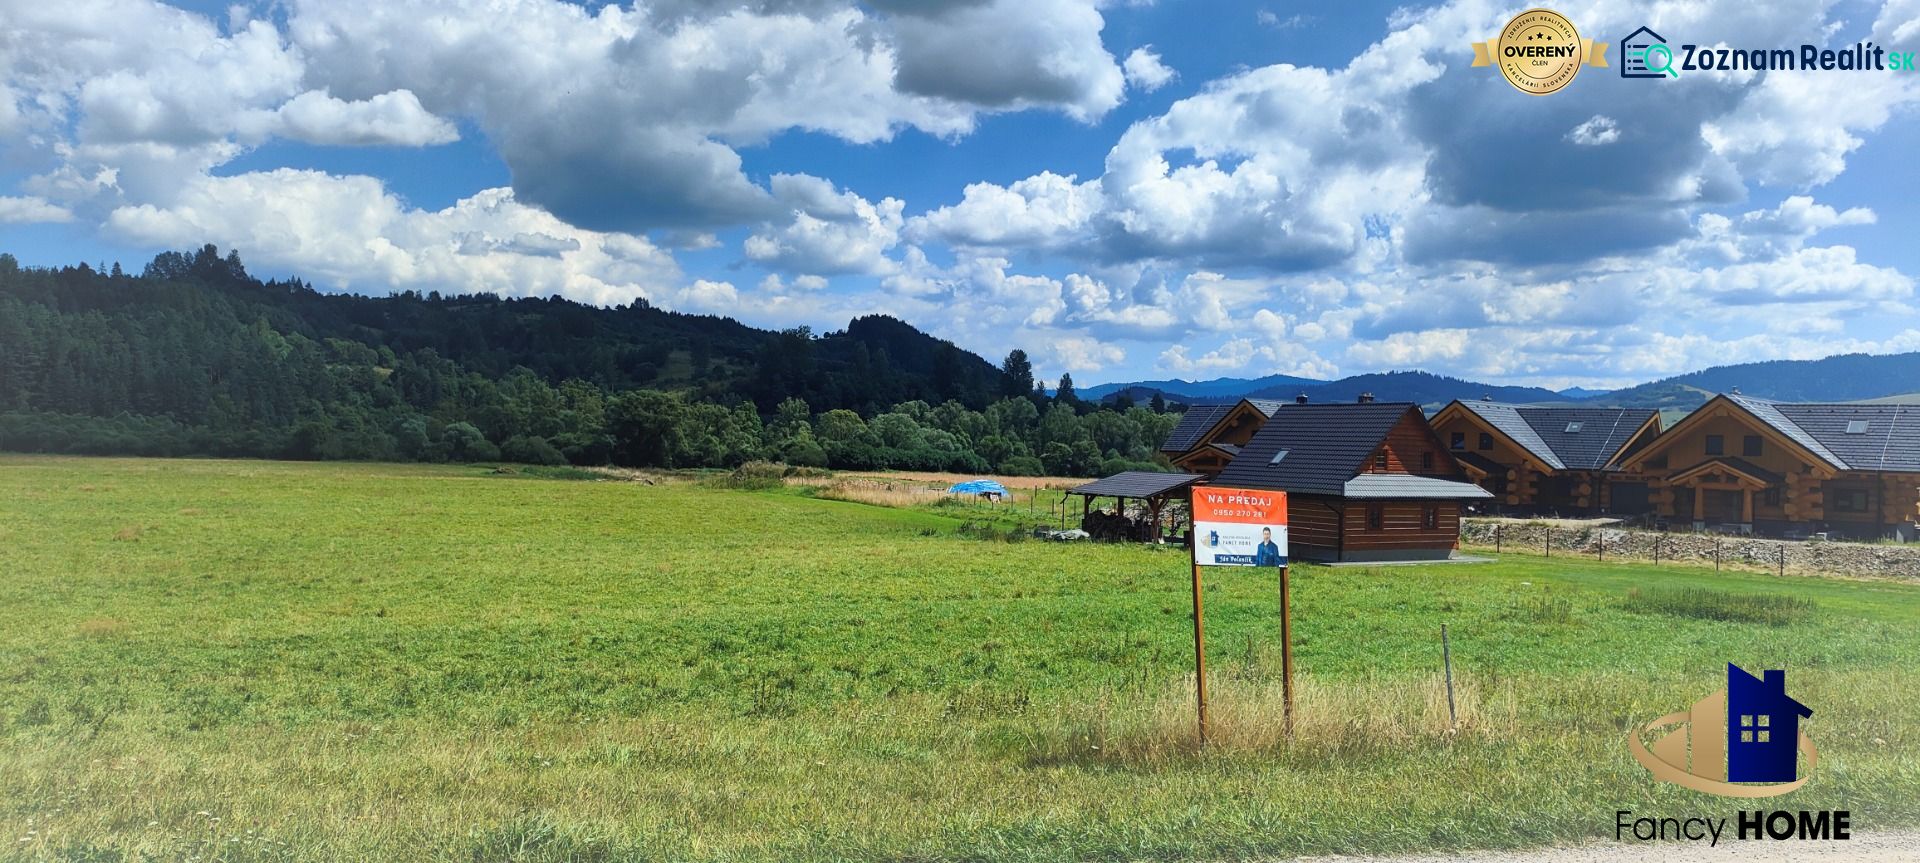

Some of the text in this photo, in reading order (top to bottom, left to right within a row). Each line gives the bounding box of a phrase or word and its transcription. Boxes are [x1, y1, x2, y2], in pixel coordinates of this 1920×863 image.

[1208, 494, 1272, 506] NA PREDAJ
[1213, 508, 1233, 516] 0950
[1236, 509, 1251, 517] 270
